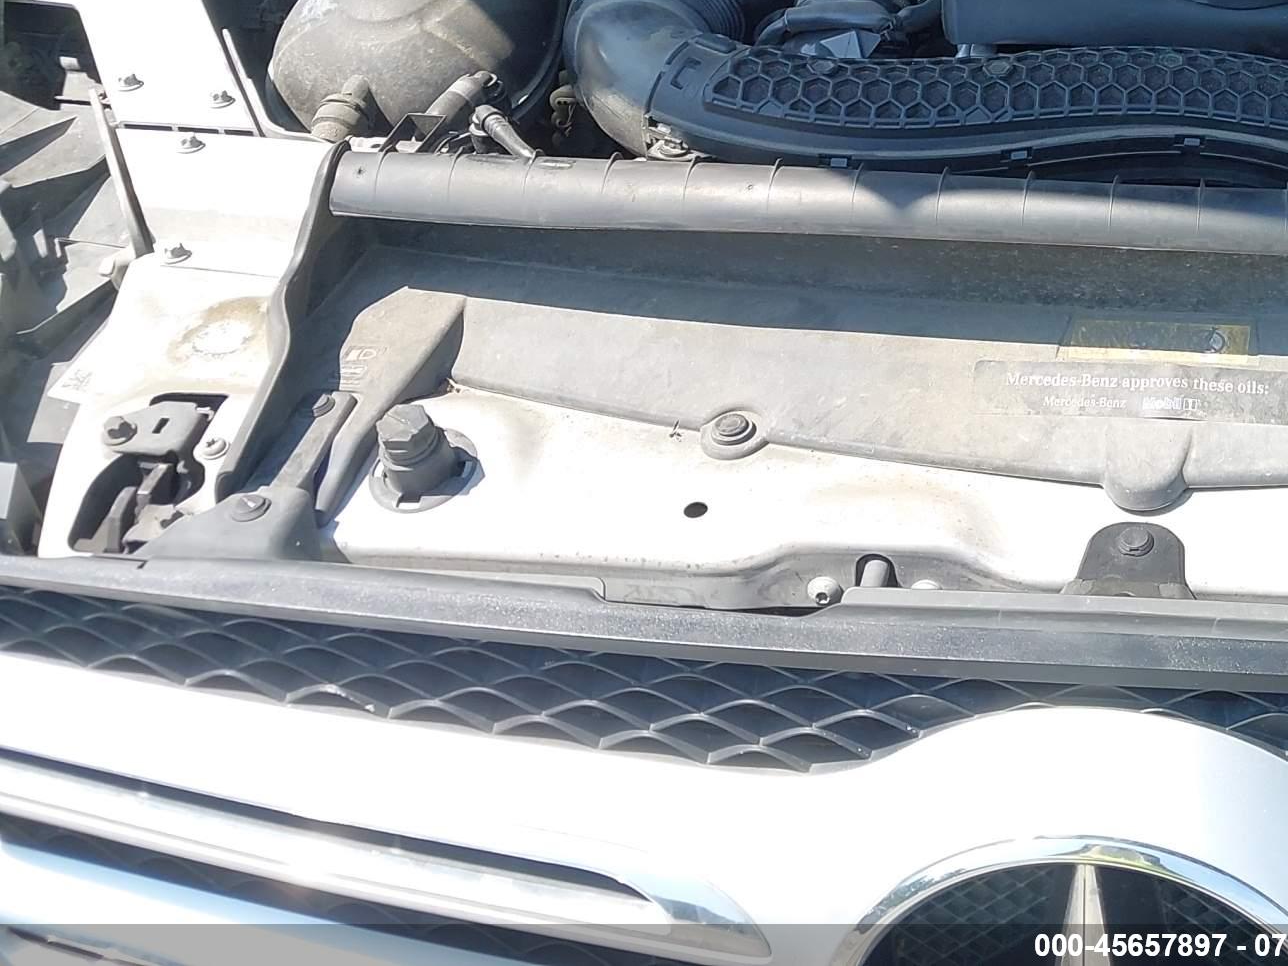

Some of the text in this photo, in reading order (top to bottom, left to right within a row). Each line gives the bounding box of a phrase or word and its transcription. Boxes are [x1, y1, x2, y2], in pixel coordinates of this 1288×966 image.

[1006, 372, 1269, 395] Mercedes-Benz approves these oils:
[1042, 395, 1127, 409] Mercedes-Benz
